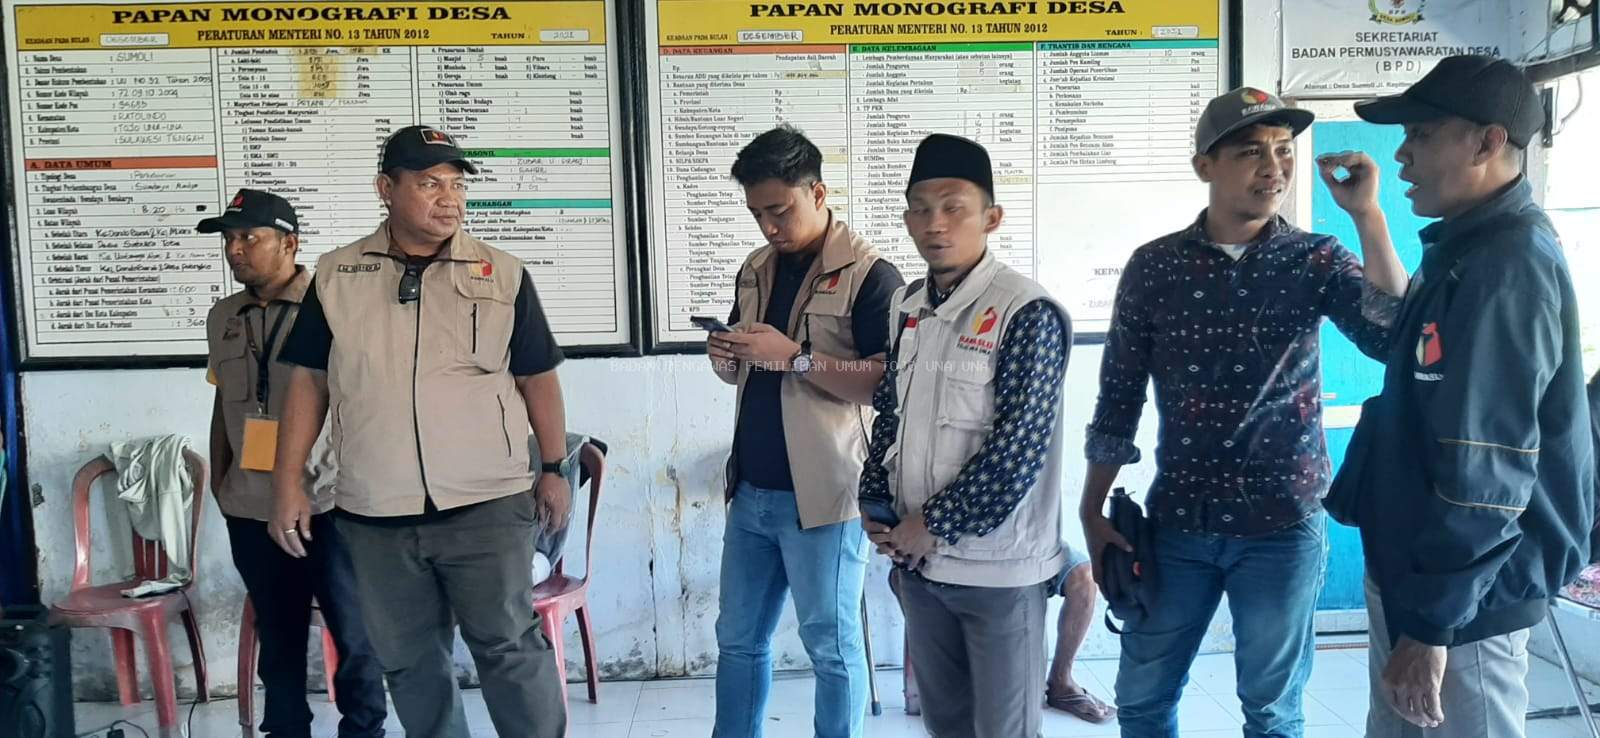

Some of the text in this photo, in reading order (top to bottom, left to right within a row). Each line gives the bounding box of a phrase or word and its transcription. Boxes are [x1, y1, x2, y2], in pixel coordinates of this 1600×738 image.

[112, 6, 512, 24] PAPAN MONOGRAFI DESA
[750, 1, 1125, 17] PAPAN MONOGRAFI DESA
[198, 29, 430, 41] PERATURAN MENTERI NO. 13 TAHUN 2012
[830, 23, 1047, 35] PERATURAN MENTERI NO. 13 TAHUN 2012
[742, 32, 799, 41] DESEMBER
[1355, 32, 1439, 42] SEKRETARIAT
[1292, 46, 1500, 59] BADAN PERMUSYAWARATAN DESA
[45, 161, 72, 169] DATA
[76, 160, 111, 168] UMUM
